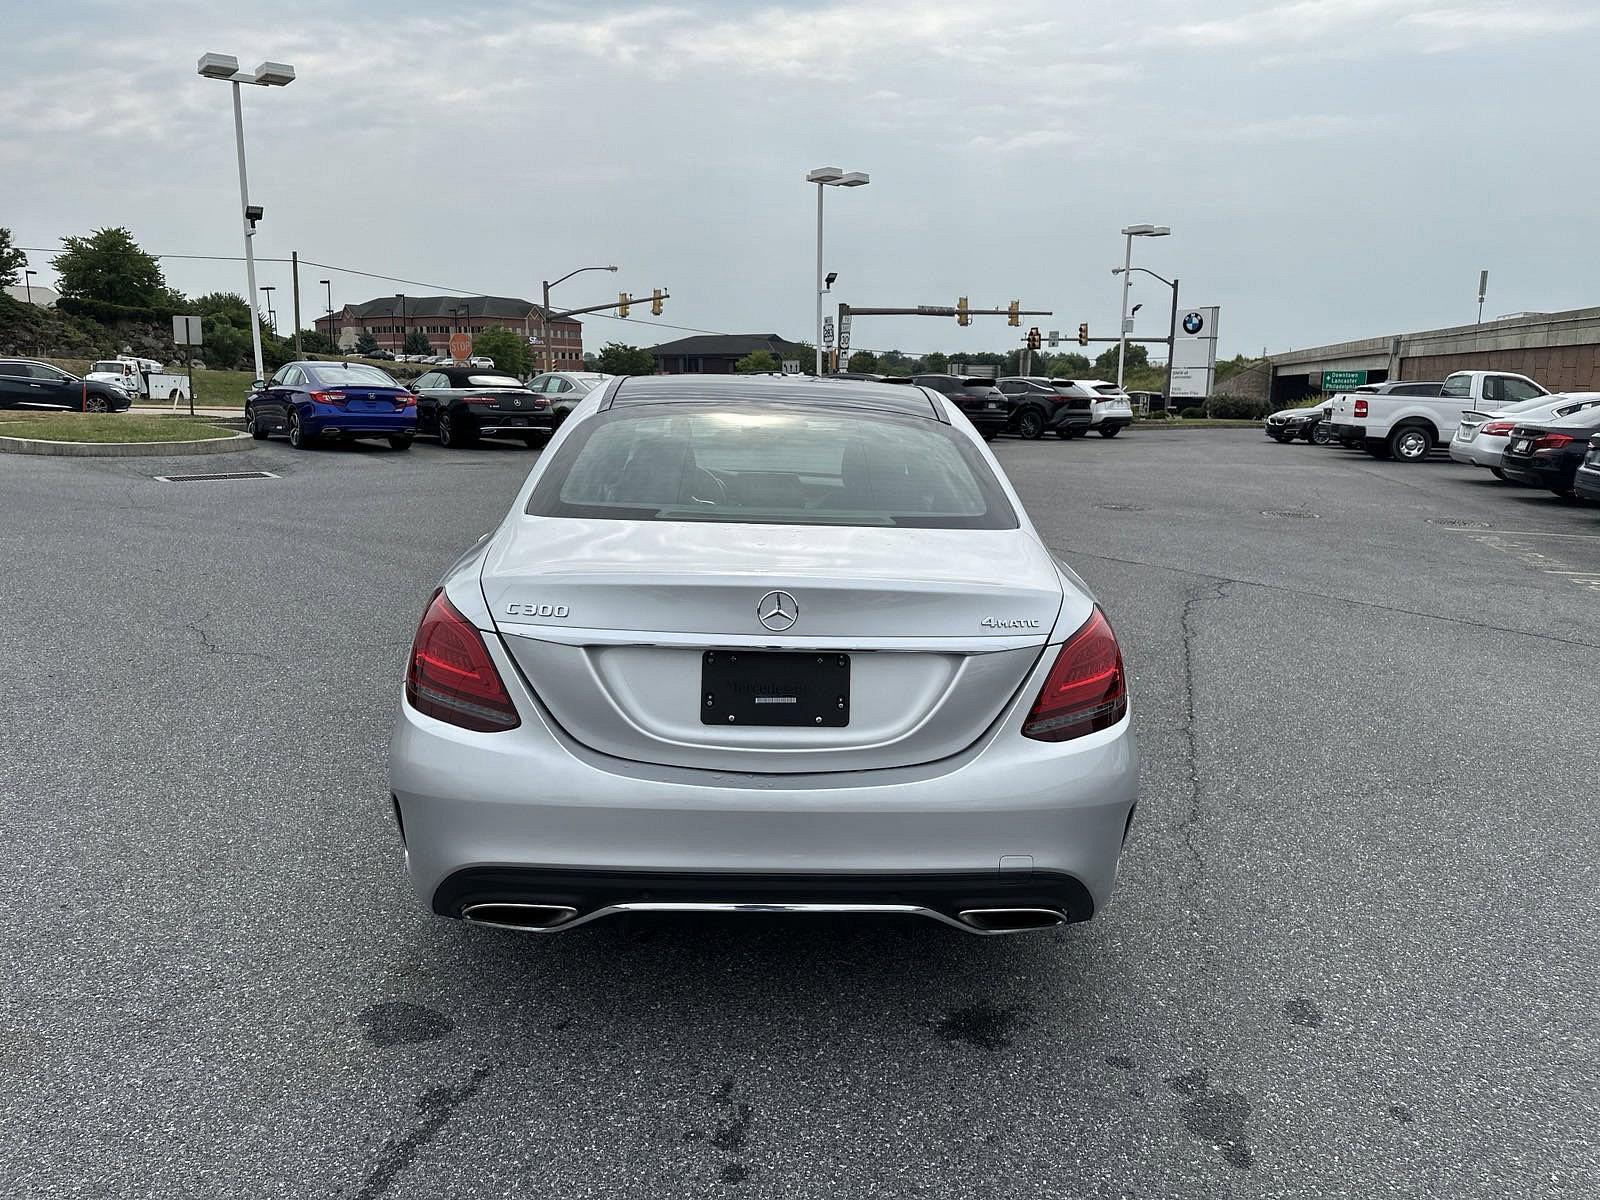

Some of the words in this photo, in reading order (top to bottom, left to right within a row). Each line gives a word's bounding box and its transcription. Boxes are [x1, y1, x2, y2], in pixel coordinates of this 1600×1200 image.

[451, 343, 471, 352] STOP
[506, 603, 520, 614] C
[522, 604, 569, 618] 300
[980, 616, 1040, 628] 4MATIC
